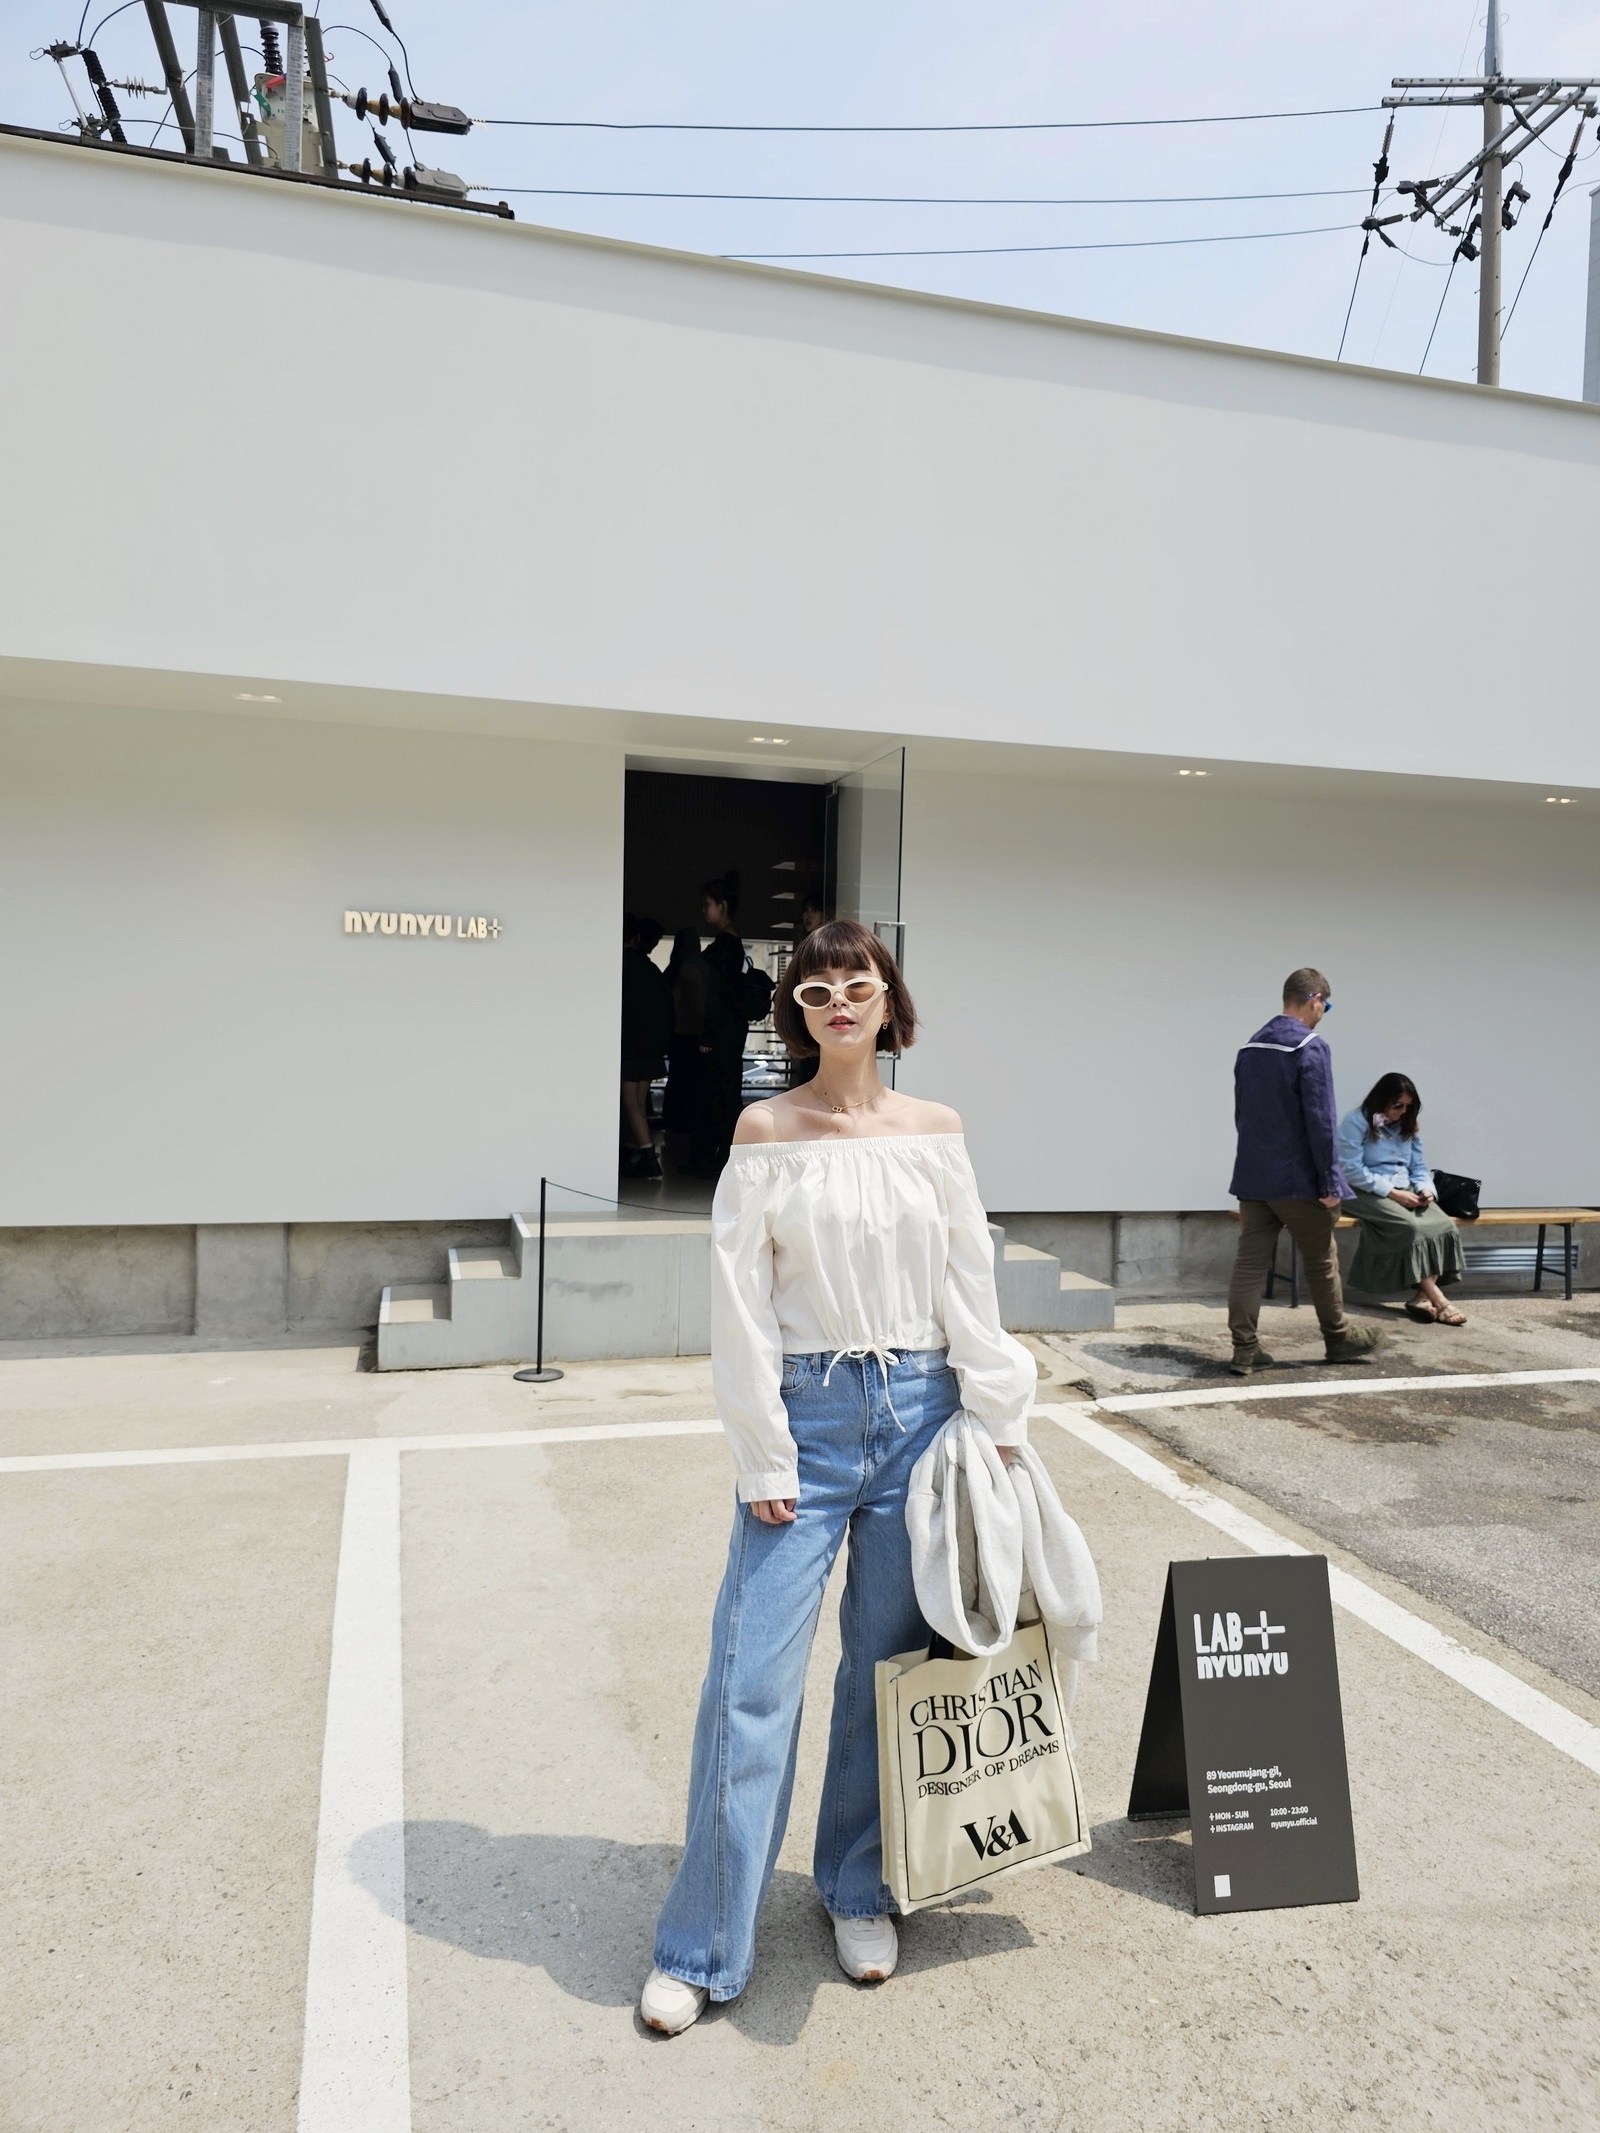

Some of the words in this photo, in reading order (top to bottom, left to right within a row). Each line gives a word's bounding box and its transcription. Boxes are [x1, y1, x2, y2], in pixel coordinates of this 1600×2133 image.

[909, 1659, 1043, 1727] CHRISTIAN
[912, 1693, 1055, 1781] DIOR
[918, 1770, 981, 1799] DESIGNER
[984, 1761, 1005, 1777] OF
[1009, 1740, 1060, 1772] DREAMS
[1206, 1770, 1217, 1780] 89
[1217, 1766, 1282, 1780] Yeonmujang-gil,
[1207, 1782, 1268, 1794] Seongdong-gu,
[1268, 1778, 1292, 1789] Seoul
[1214, 1812, 1231, 1821] MON
[1234, 1810, 1249, 1819] SUN
[1215, 1822, 1254, 1833] INSTAGRAM
[960, 1809, 1032, 1861] V&A
